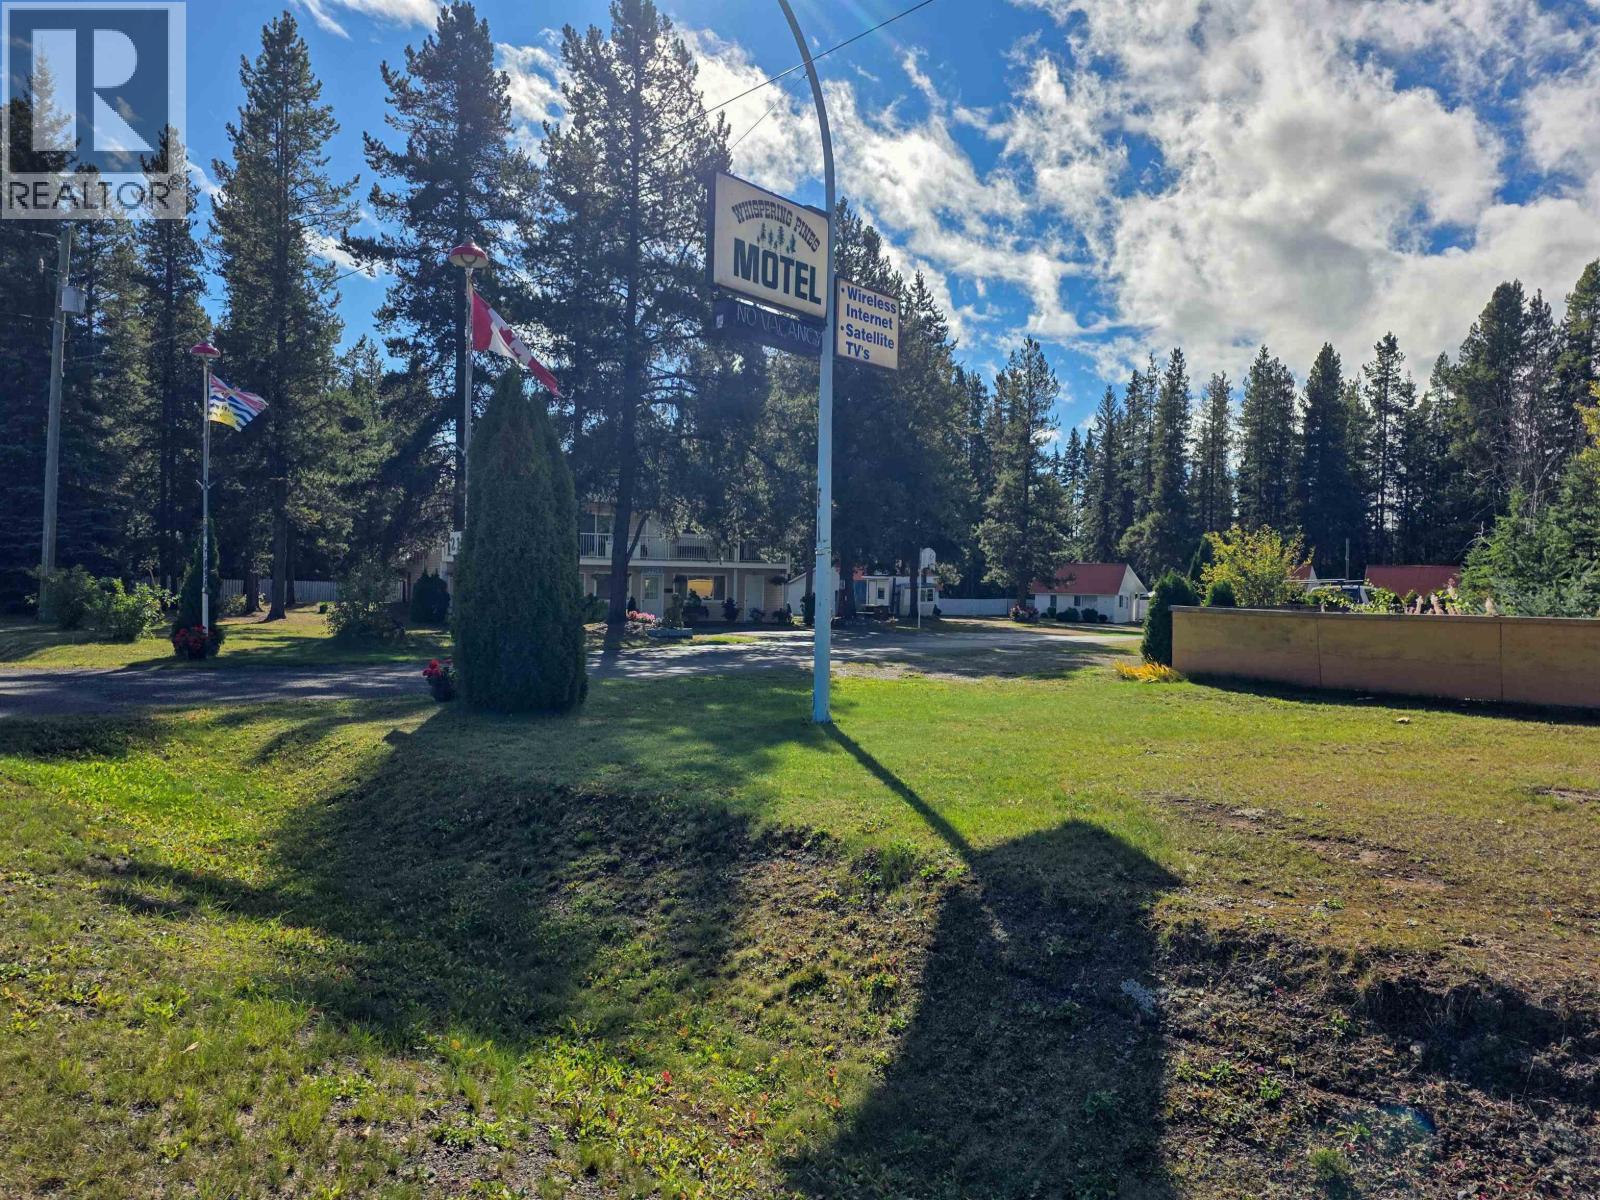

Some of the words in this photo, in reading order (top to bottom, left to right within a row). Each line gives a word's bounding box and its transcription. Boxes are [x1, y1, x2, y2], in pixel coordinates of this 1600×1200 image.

[731, 199, 793, 226] WHISPERING
[795, 216, 821, 253] PINES
[733, 238, 822, 305] MOTEL
[847, 285, 897, 314] Wireless
[736, 304, 758, 327] NO
[846, 305, 893, 330] Internet
[845, 323, 895, 350] Satellite
[846, 341, 871, 360] TV's
